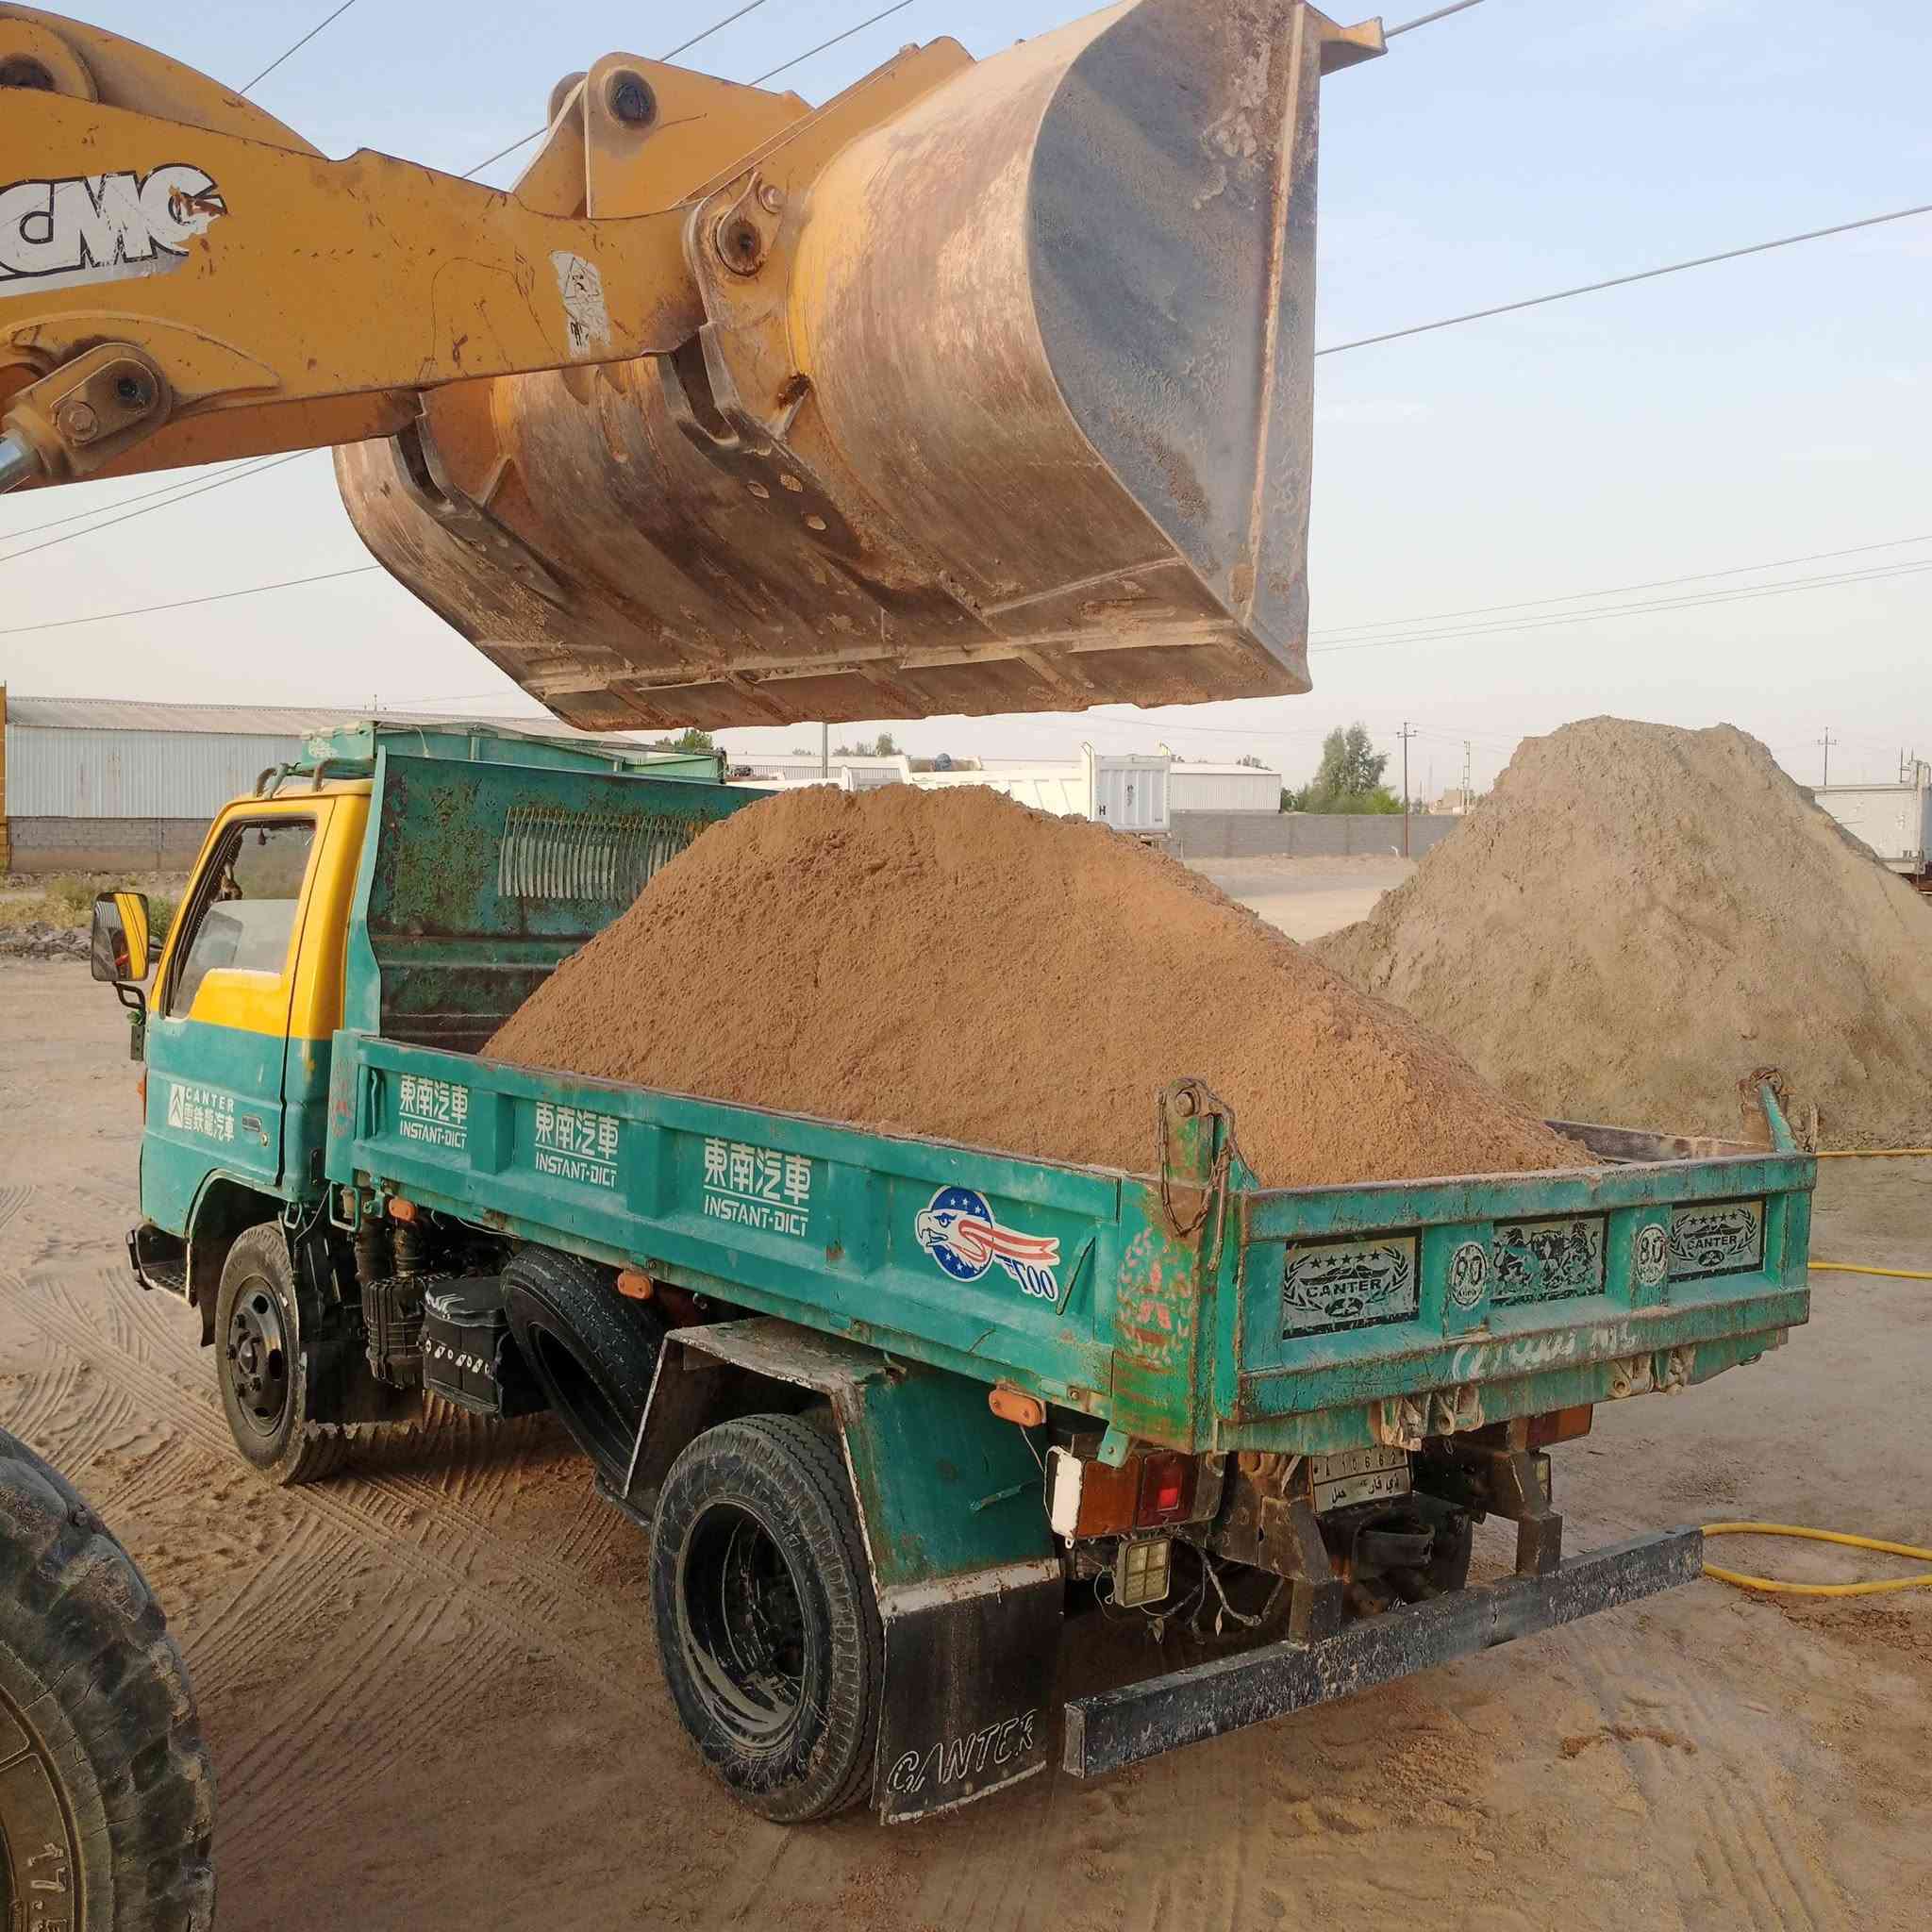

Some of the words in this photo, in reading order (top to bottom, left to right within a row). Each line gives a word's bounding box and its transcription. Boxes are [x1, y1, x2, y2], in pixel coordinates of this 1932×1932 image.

[185, 1086, 235, 1113] CANTER
[535, 1101, 620, 1160] 東南汽車
[704, 1137, 812, 1207] 東南汽車
[1688, 1235, 1738, 1250] CANTER
[1306, 1278, 1382, 1298] CANTER
